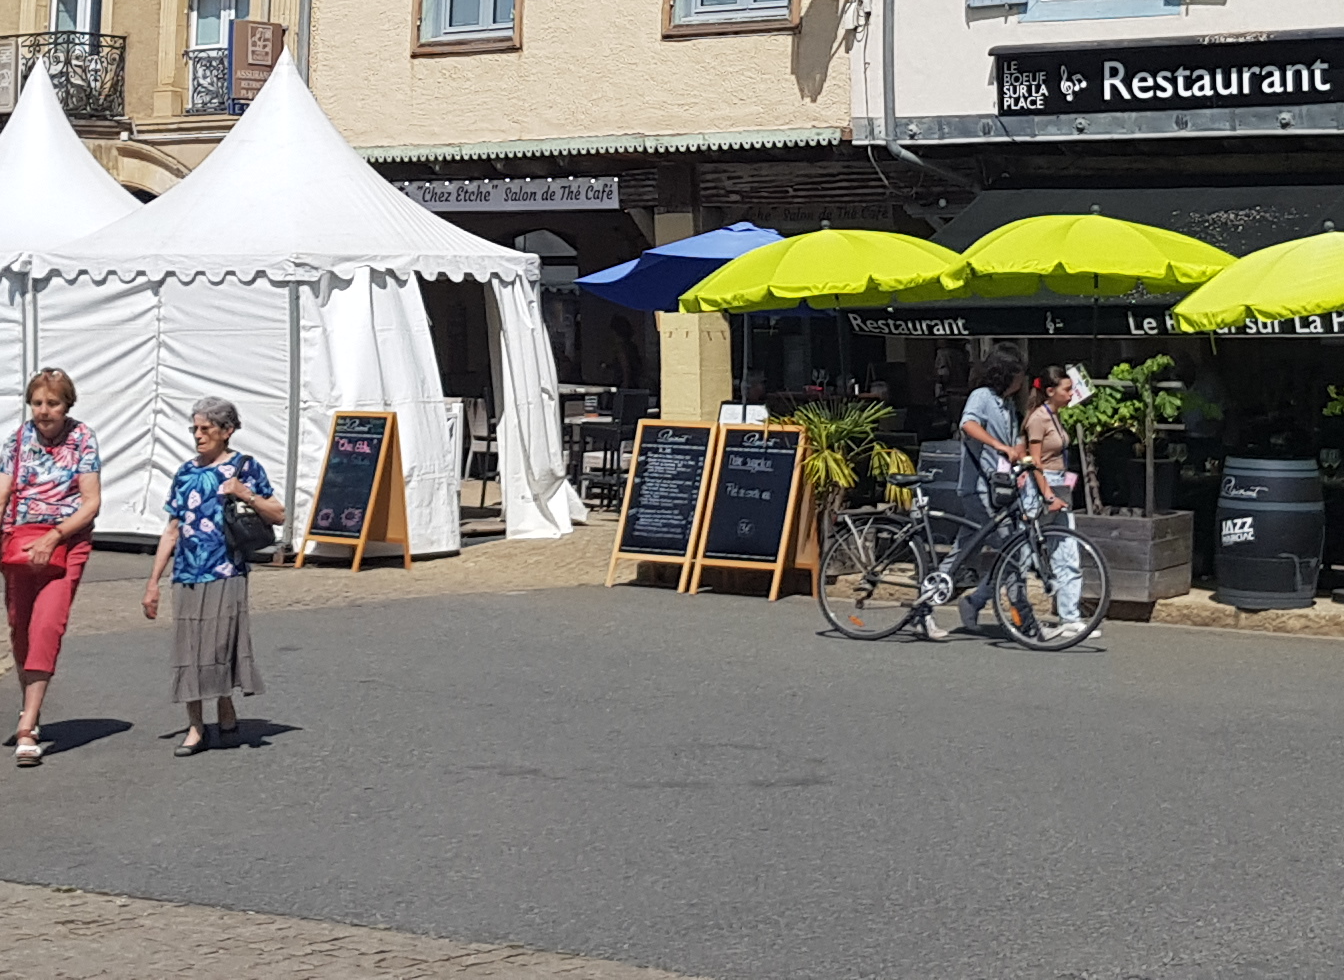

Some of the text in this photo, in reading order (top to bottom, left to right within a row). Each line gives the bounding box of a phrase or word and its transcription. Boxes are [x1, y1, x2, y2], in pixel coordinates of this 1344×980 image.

[1003, 61, 1018, 74] LE
[1003, 71, 1047, 86] BOEUF
[1103, 58, 1331, 100] Restaurant
[1003, 83, 1049, 98] SUR LA
[1003, 96, 1045, 110] PLACE
[416, 184, 614, 203] "Chez Etche" Salon de Thé Café
[847, 312, 969, 335] Restaurant
[1128, 310, 1158, 334] Le
[1245, 316, 1285, 333] sur
[1294, 314, 1324, 333] La
[1222, 516, 1254, 534] JAZZ
